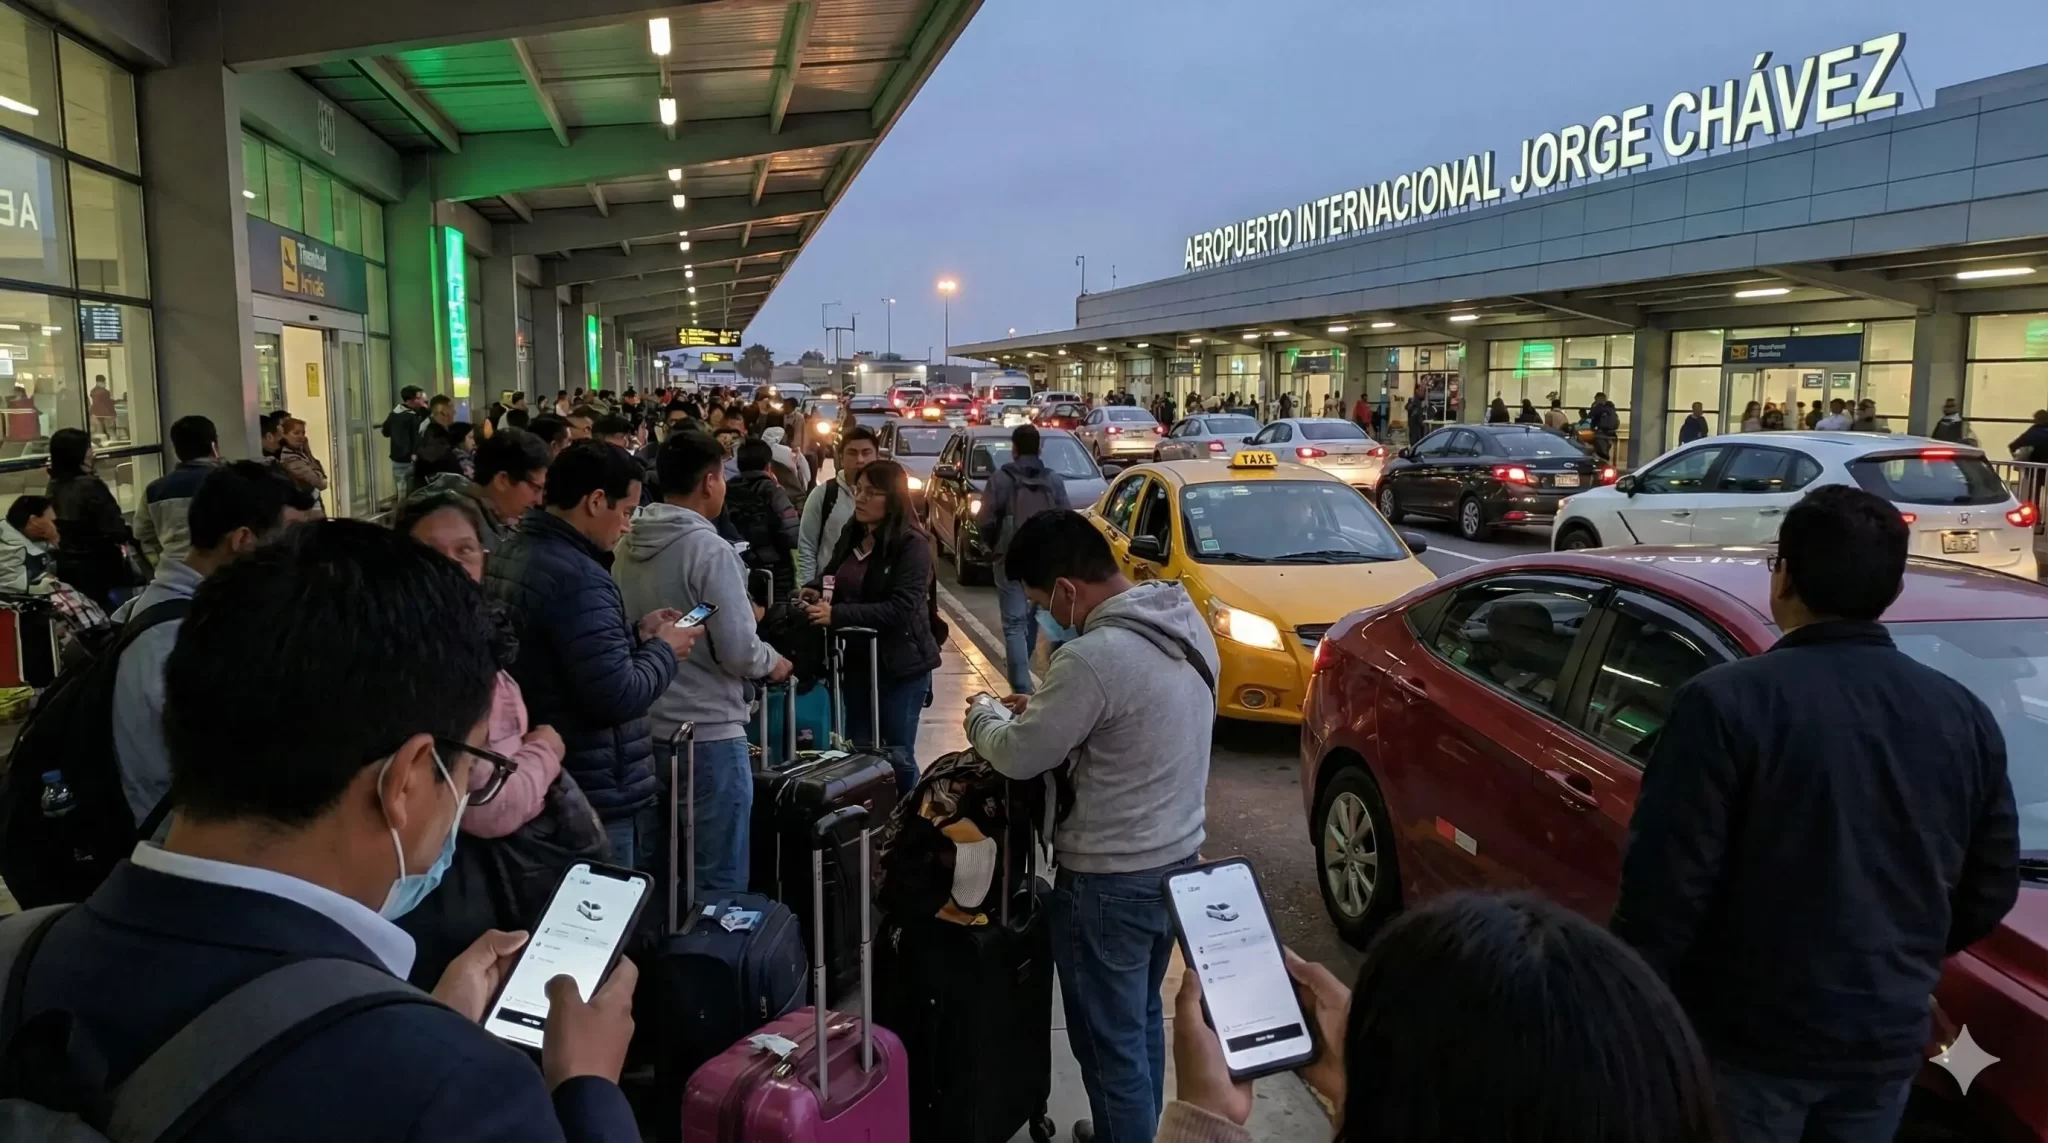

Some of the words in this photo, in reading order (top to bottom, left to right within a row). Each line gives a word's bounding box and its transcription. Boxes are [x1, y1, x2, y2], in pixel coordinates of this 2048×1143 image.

[1184, 208, 1293, 270] AEROPUERTO
[1296, 150, 1502, 244] INTERNACIONAL
[1510, 103, 1653, 194] JORGE
[1663, 32, 1905, 158] CHÁVEZ
